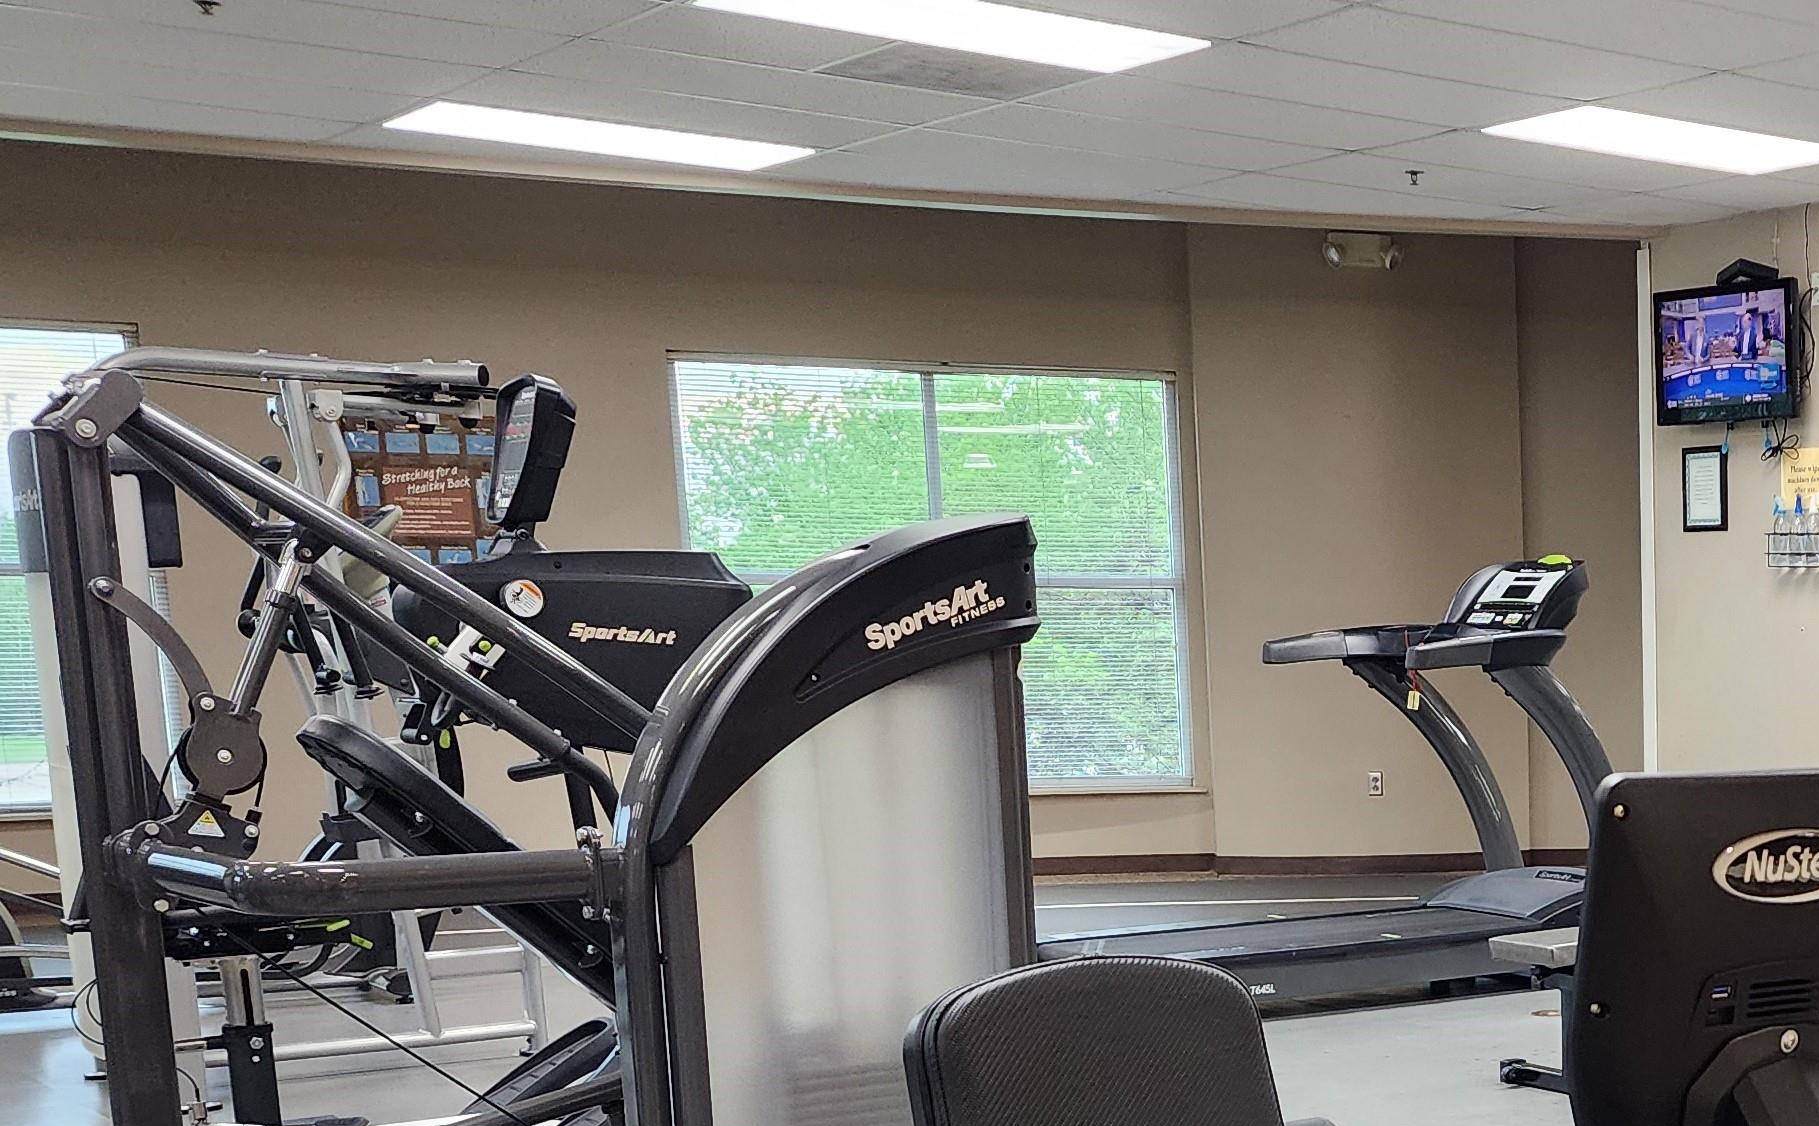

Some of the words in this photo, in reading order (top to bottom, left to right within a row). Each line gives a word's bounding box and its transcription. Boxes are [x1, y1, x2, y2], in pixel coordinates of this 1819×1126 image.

[382, 469, 434, 486] Stretching
[435, 466, 450, 480] for
[451, 466, 458, 475] a
[407, 481, 445, 495] Healthy
[447, 476, 471, 489] Back
[865, 579, 989, 650] SportsArt
[951, 597, 1005, 628] FITNESS
[568, 622, 677, 645] SportsArt
